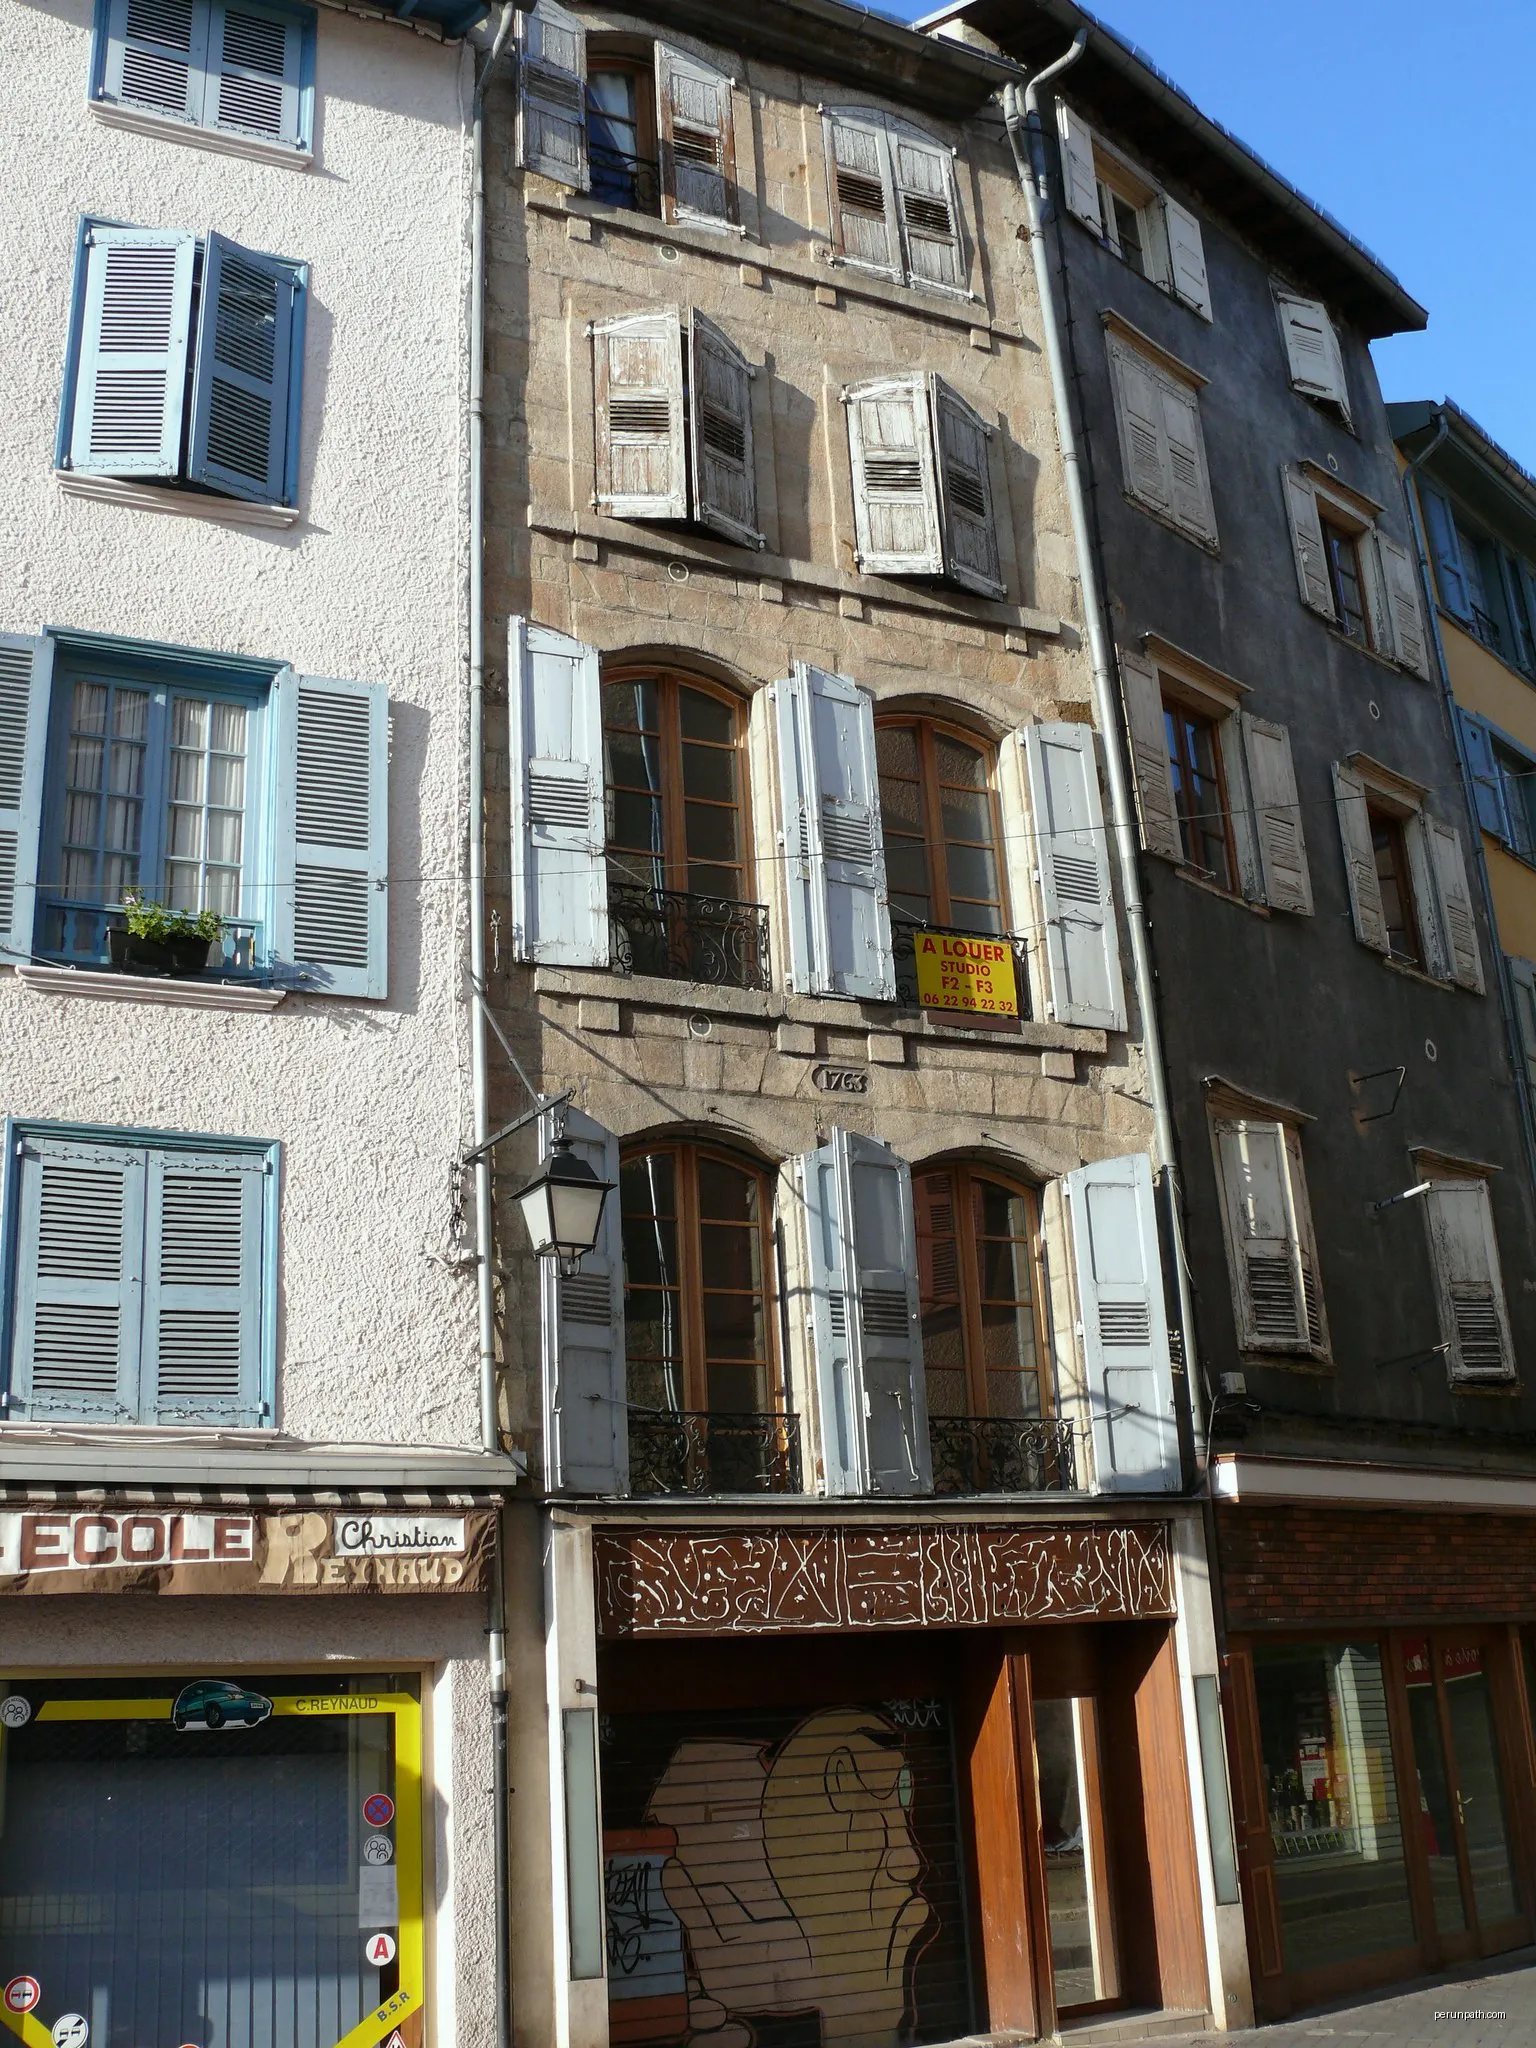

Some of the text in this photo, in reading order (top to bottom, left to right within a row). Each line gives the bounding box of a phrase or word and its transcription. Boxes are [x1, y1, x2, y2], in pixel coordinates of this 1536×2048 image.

[922, 937, 1005, 962] A LOUER
[941, 961, 990, 976] STUDIO
[941, 976, 960, 991] F2
[976, 979, 993, 994] F3
[924, 993, 1014, 1012] 06 22 94 22 32
[822, 1069, 865, 1092] 1763
[341, 1520, 457, 1550] Christian
[258, 1512, 464, 1585] REYNAUD
[295, 1697, 378, 1712] C.REYNAUD
[373, 1937, 389, 1959] A
[376, 1991, 410, 2022] B.S.R
